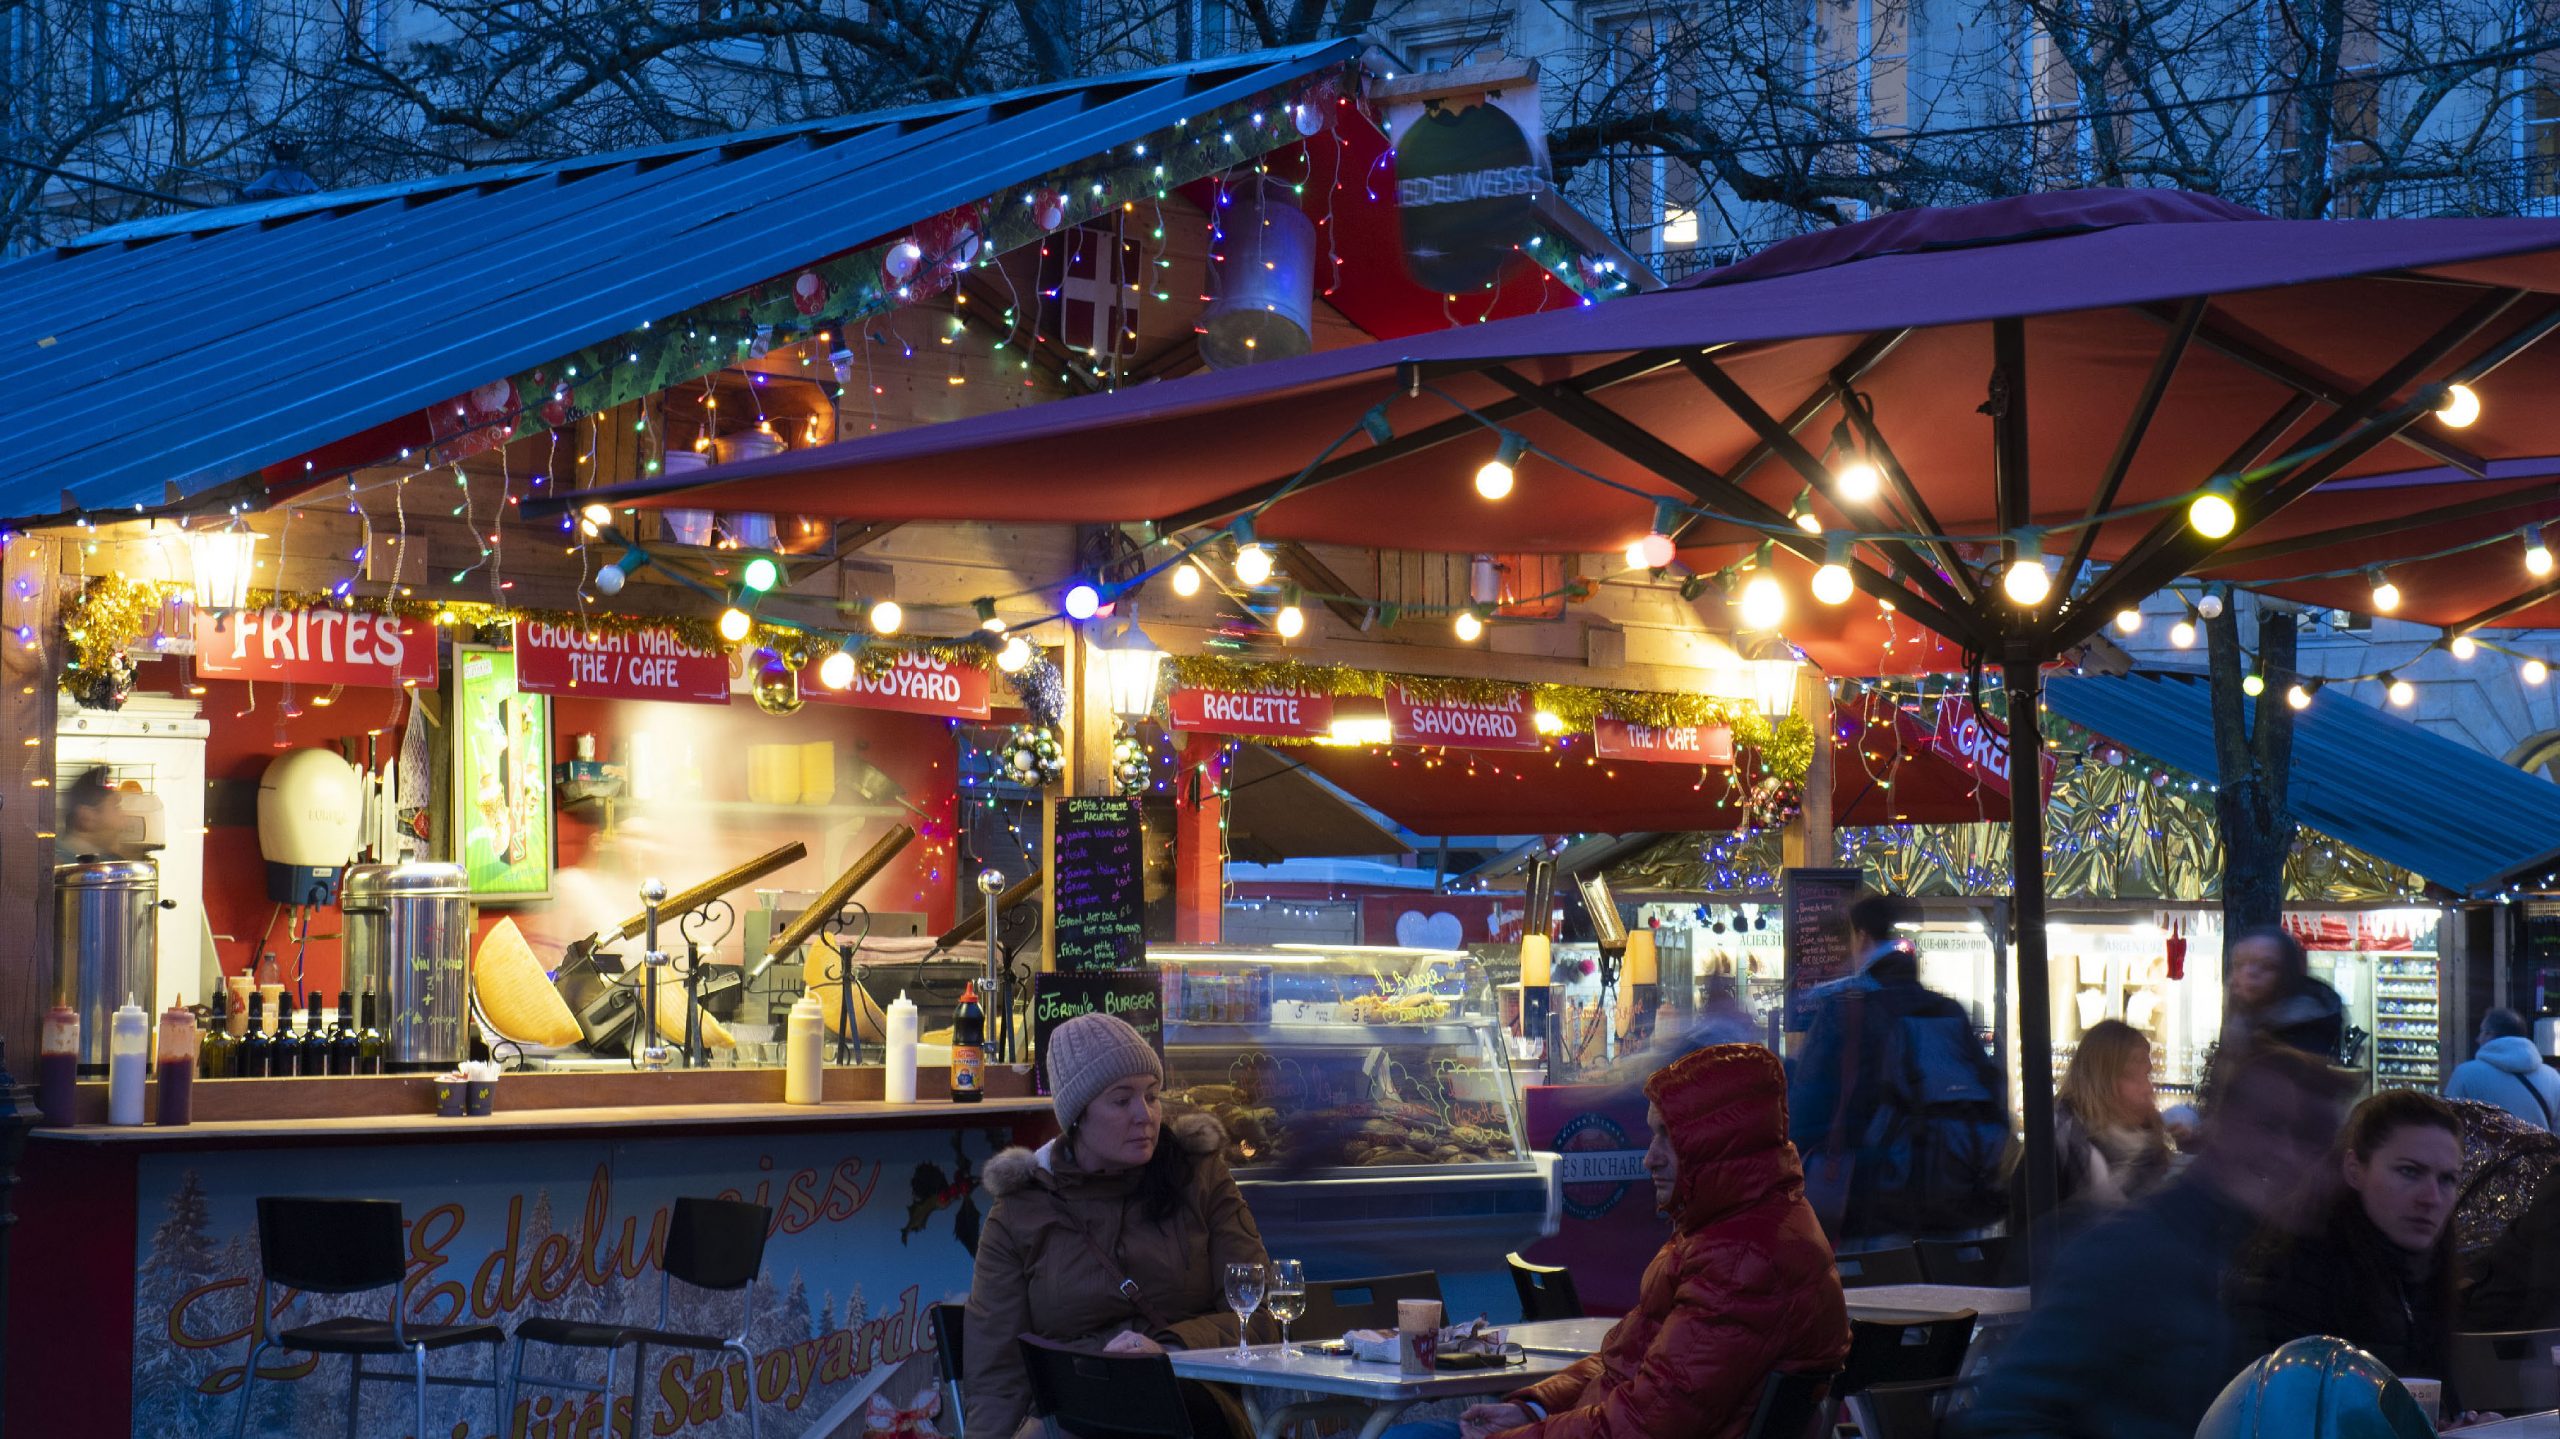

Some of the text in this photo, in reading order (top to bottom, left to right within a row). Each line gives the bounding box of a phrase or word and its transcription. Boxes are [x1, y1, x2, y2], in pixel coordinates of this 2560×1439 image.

[231, 608, 406, 667] FRITES
[568, 652, 609, 683] THE
[628, 656, 680, 688] CAFE
[1203, 693, 1301, 725] RACLETTE
[1411, 708, 1517, 738] SAVOYARD
[1626, 724, 1654, 749] THE
[1665, 727, 1700, 751] CAFE
[1740, 934, 1768, 946] ACIER
[1951, 939, 1987, 950] 750/000
